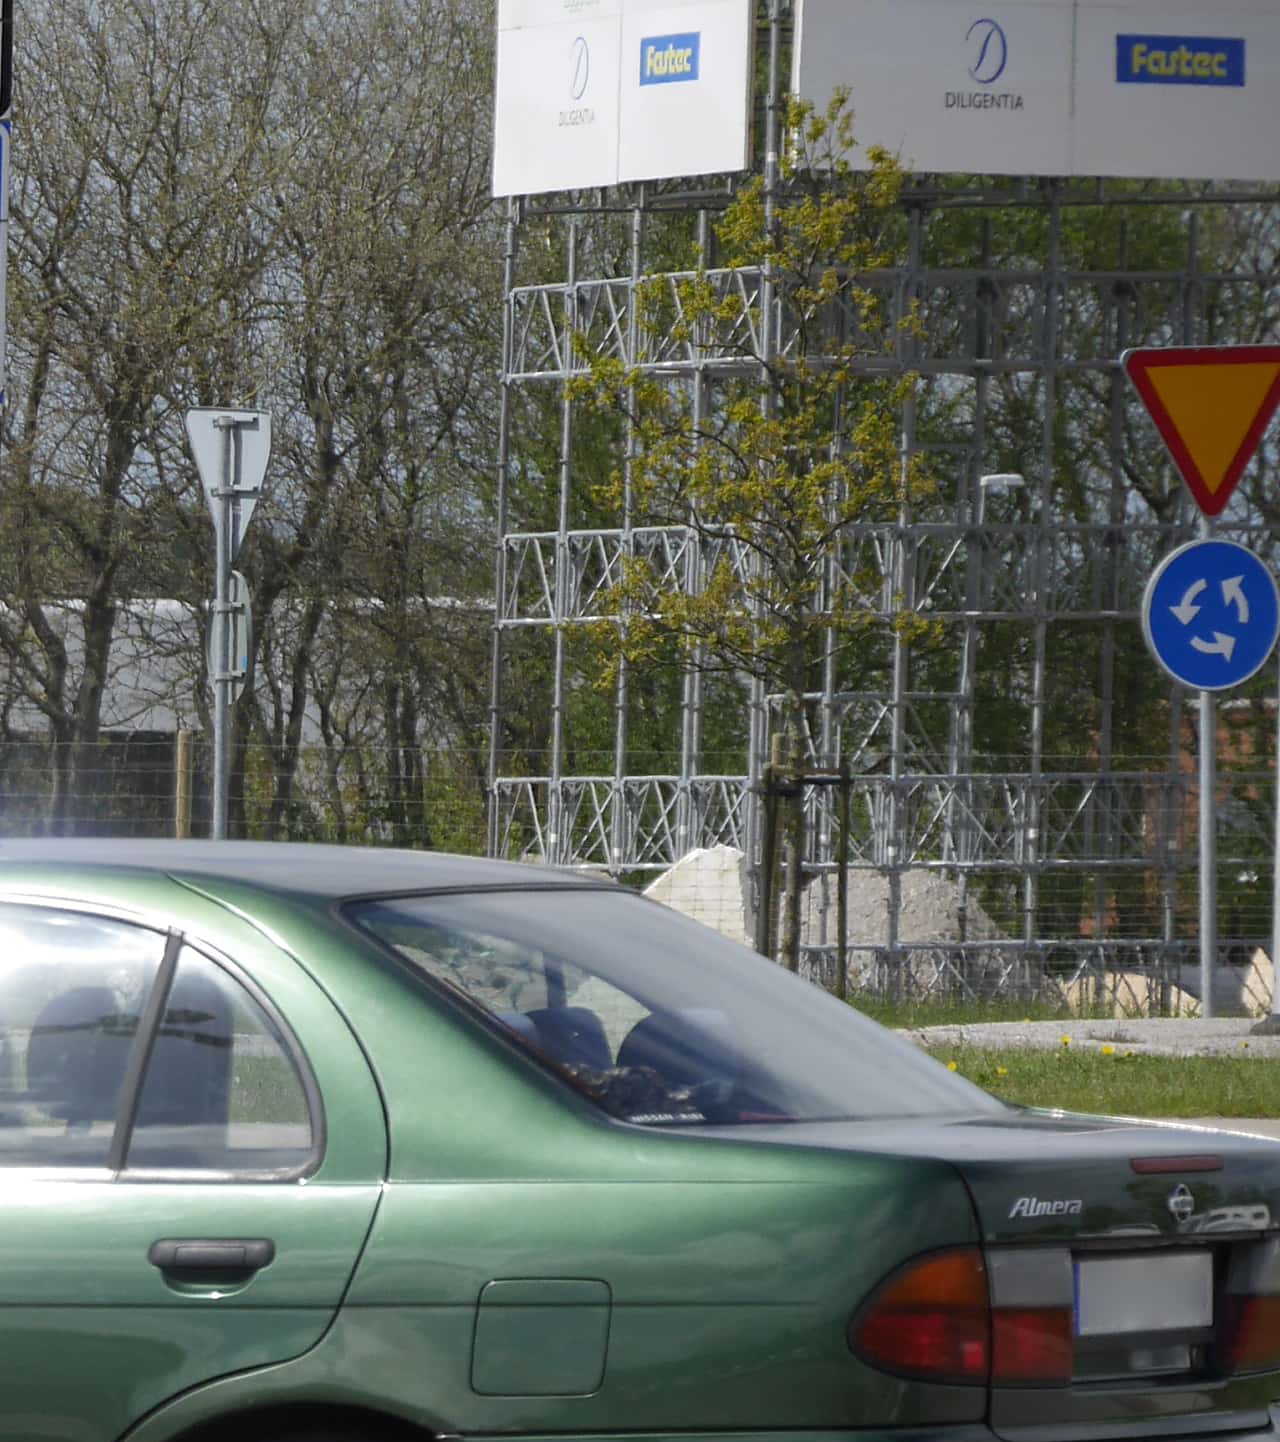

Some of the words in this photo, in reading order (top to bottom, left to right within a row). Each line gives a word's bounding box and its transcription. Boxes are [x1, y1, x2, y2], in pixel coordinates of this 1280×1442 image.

[646, 44, 692, 78] Fastec
[1132, 43, 1227, 77] Fastec
[945, 92, 1024, 110] DILIGENTIA
[1008, 1198, 1083, 1219] Almera
